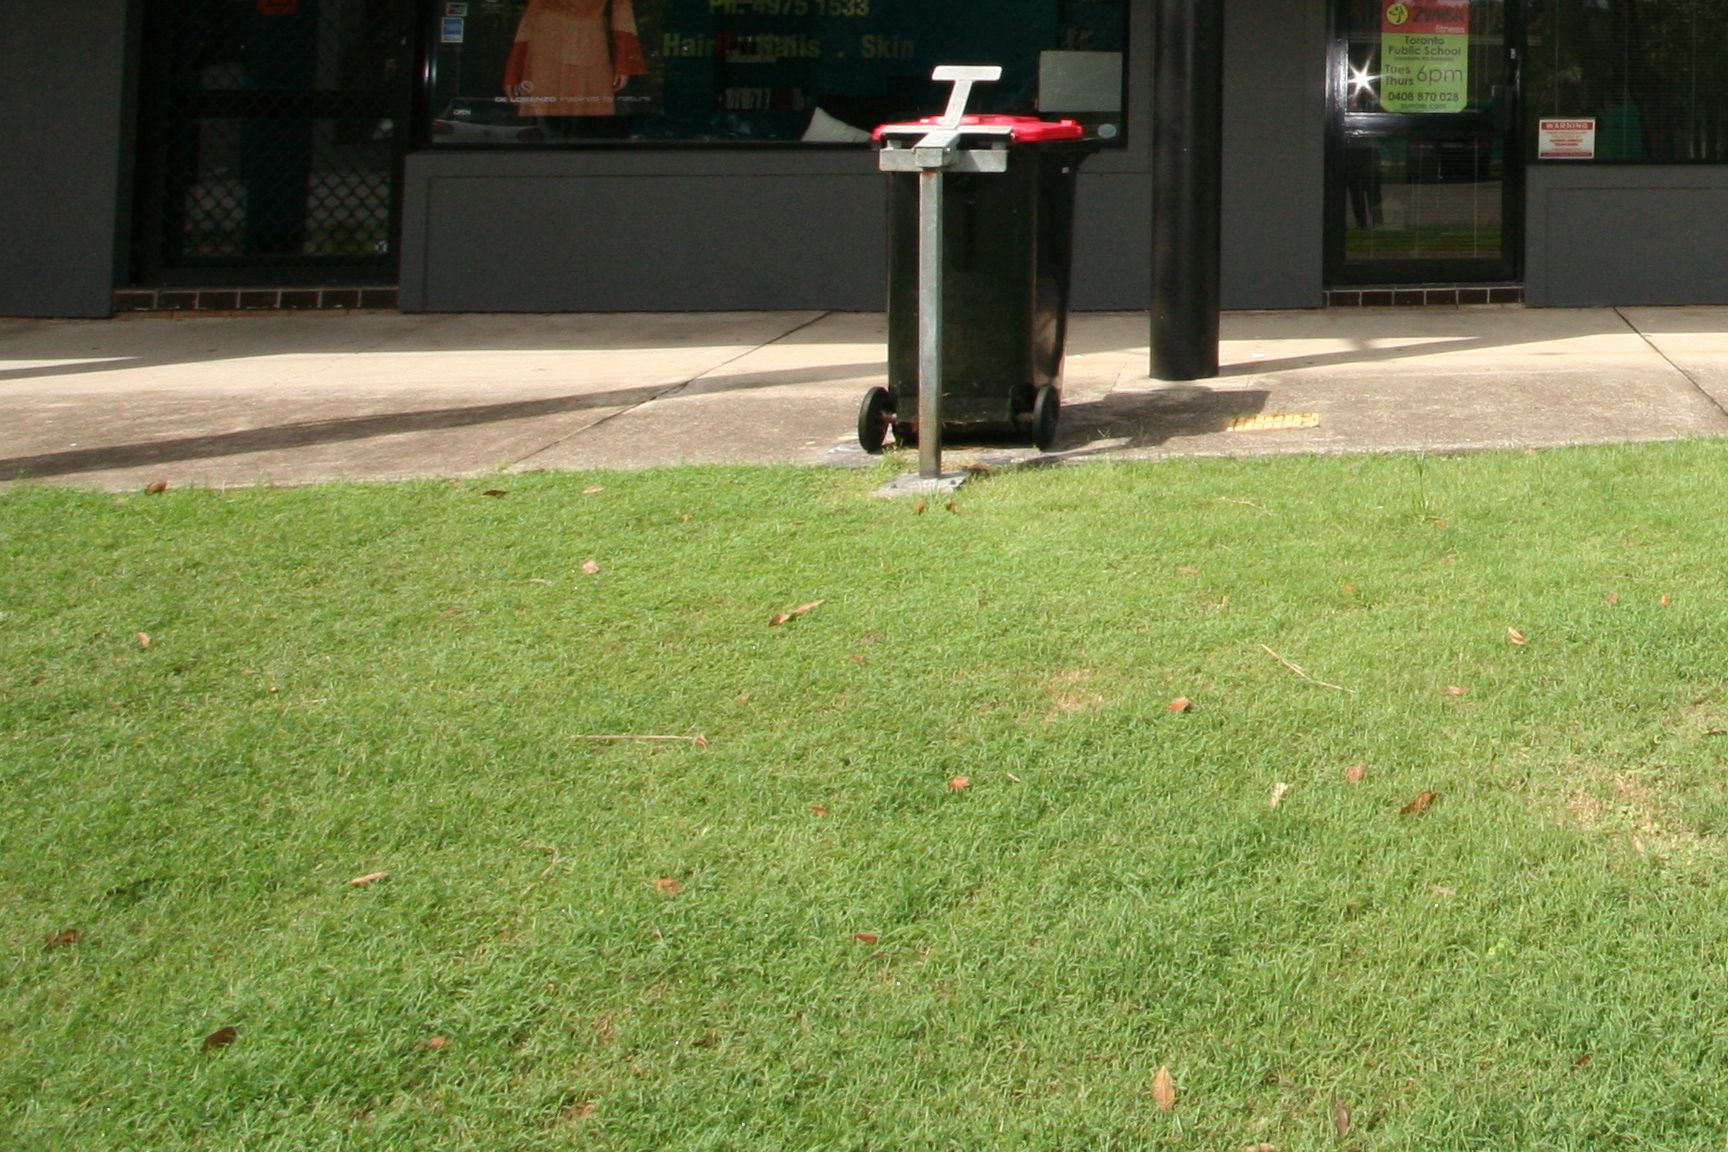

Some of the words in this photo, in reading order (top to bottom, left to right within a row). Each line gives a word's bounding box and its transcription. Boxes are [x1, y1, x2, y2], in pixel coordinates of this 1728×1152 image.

[1405, 36, 1444, 45] Toronto
[663, 33, 714, 57] Hair
[861, 34, 914, 59] Skin
[1389, 46, 1420, 55] Public
[1424, 47, 1460, 55] School
[1385, 65, 1410, 74] Tues
[1417, 65, 1462, 86] 6pm
[1385, 77, 1413, 85] Thurs
[1388, 92, 1414, 101] 0408
[1417, 93, 1437, 101] 870
[1440, 93, 1459, 101] 028
